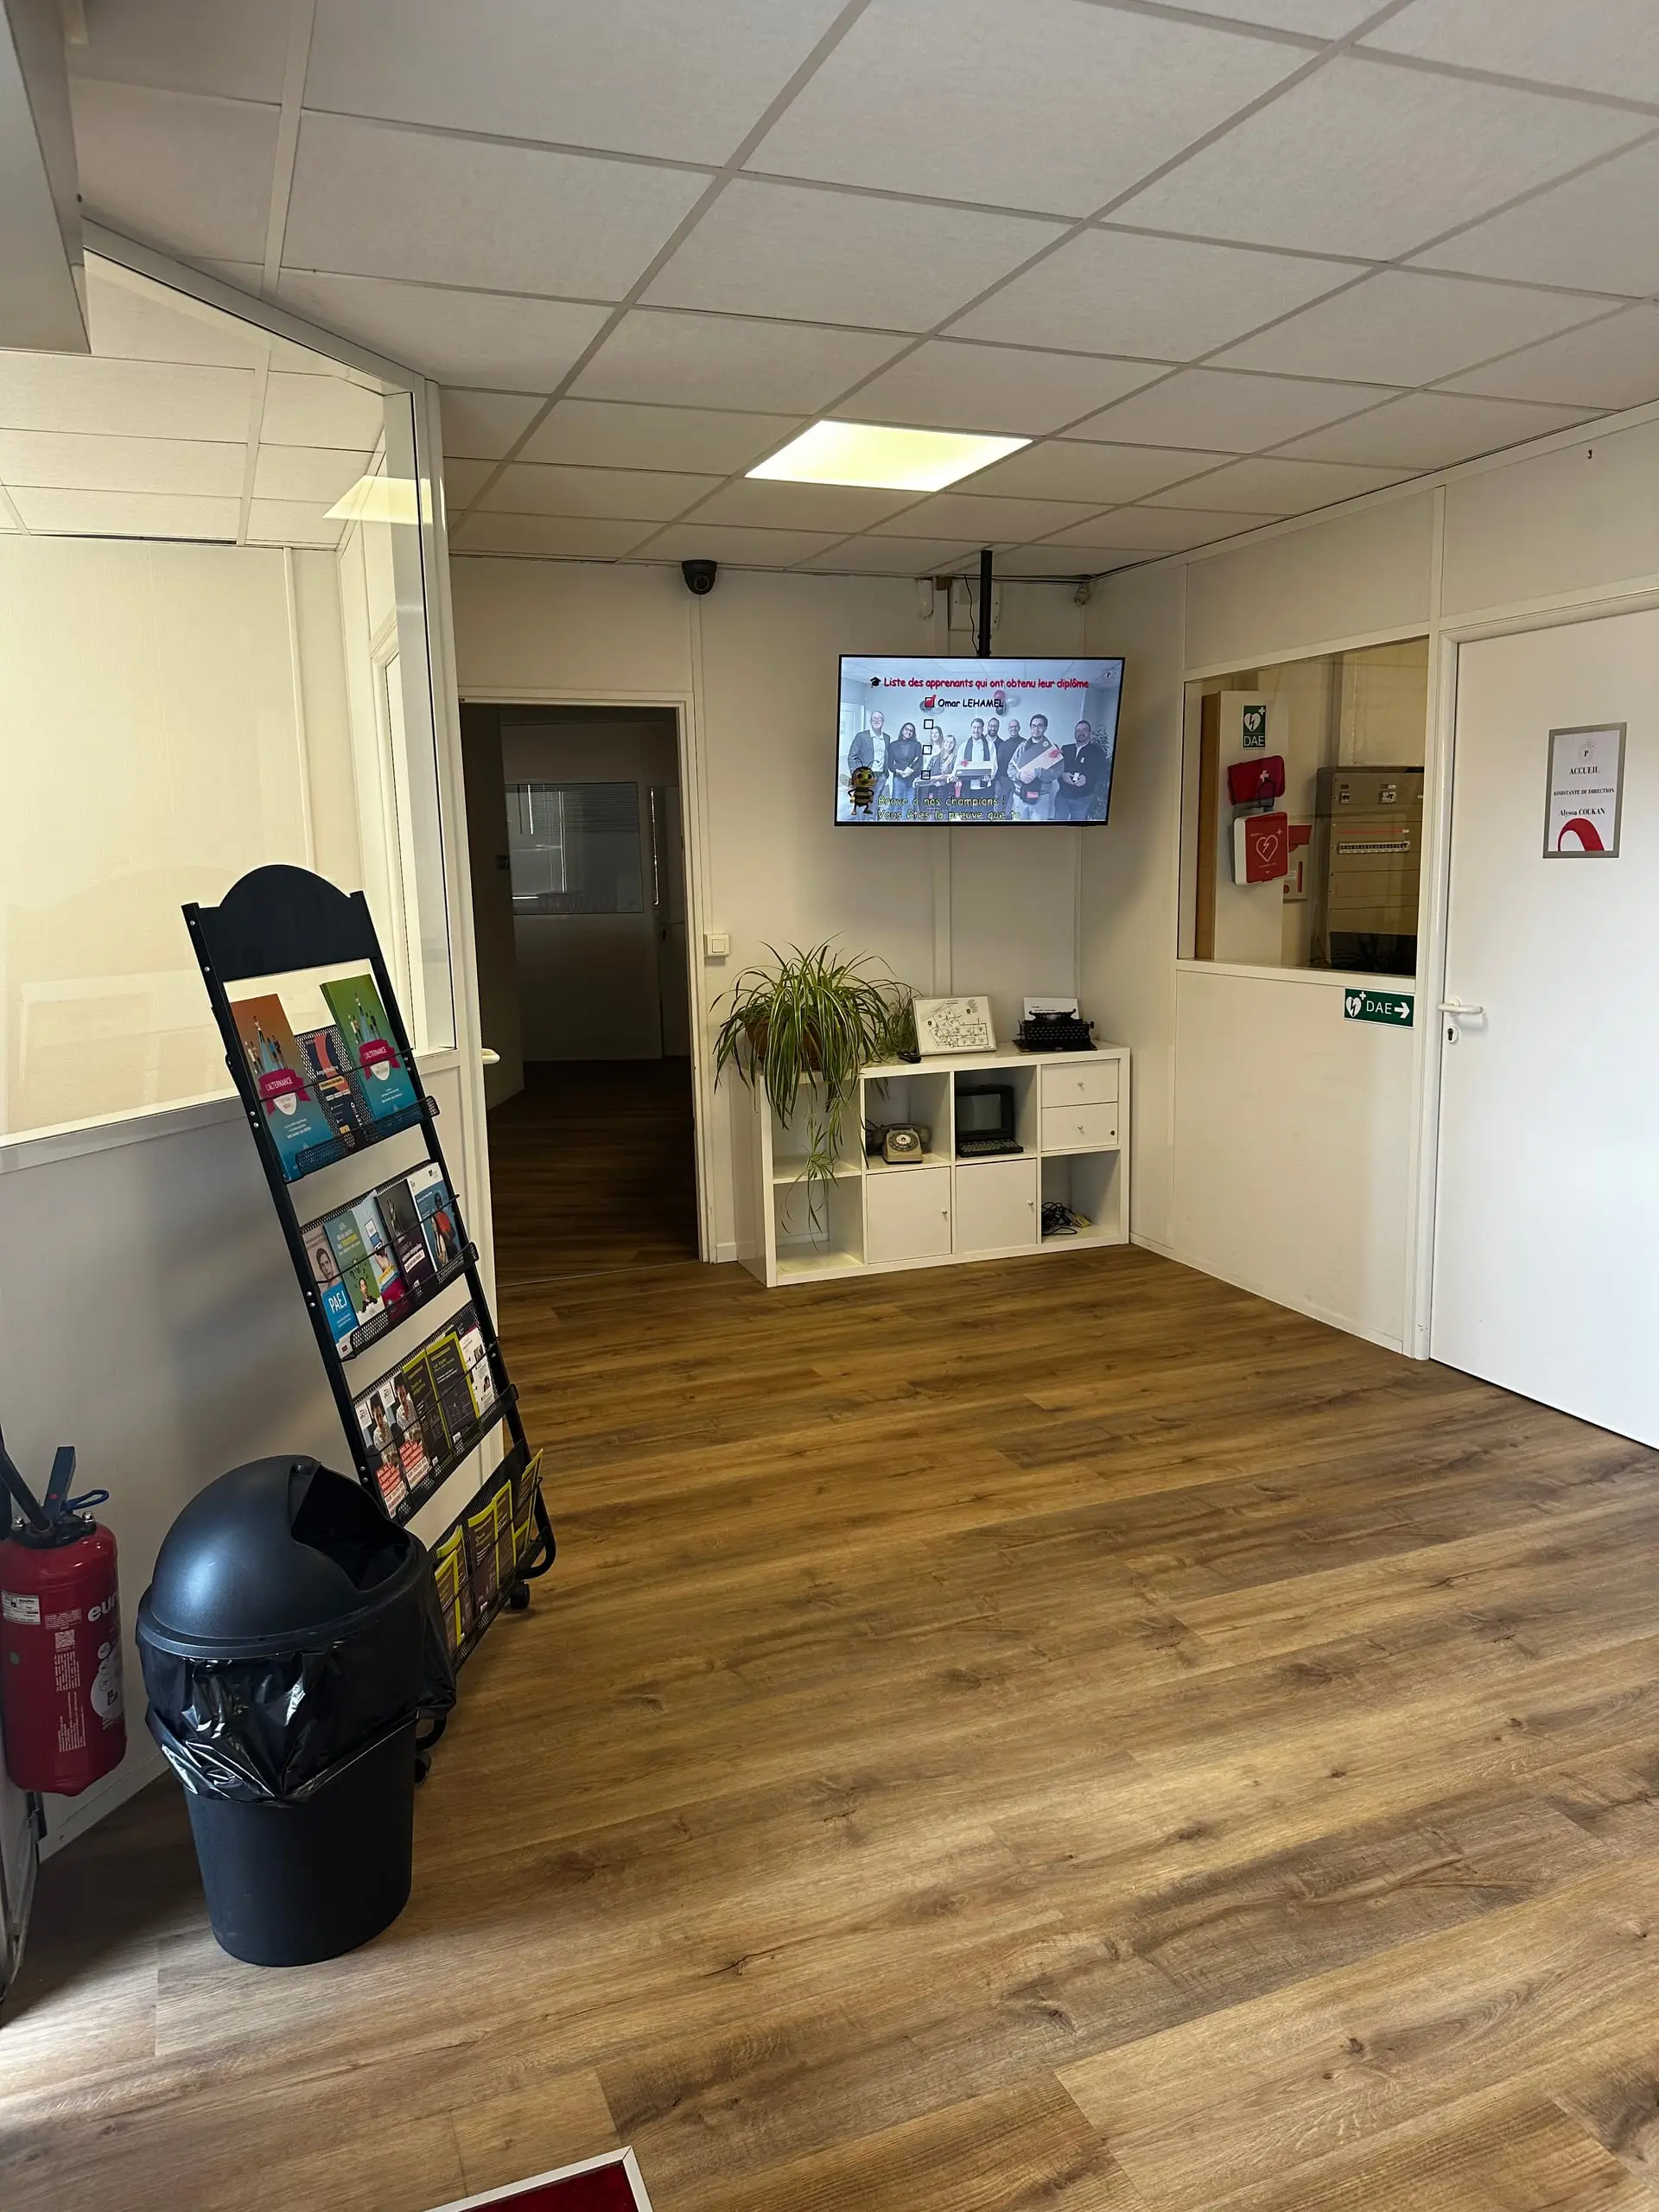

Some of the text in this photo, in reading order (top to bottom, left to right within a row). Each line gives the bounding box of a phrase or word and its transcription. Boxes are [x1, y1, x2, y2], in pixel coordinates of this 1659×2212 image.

[884, 677, 1089, 690] Liste des apprenants qui ont obtenu leur diplôme
[938, 698, 1004, 708] Omar LEHAMEL
[1243, 734, 1265, 747] DAE
[1569, 766, 1599, 775] ACCUEIL
[924, 797, 940, 805] nos
[878, 810, 902, 819] Vous
[1559, 809, 1577, 817] Alyssa
[1365, 1000, 1393, 1015] DAE
[328, 1289, 348, 1314] PAEJ
